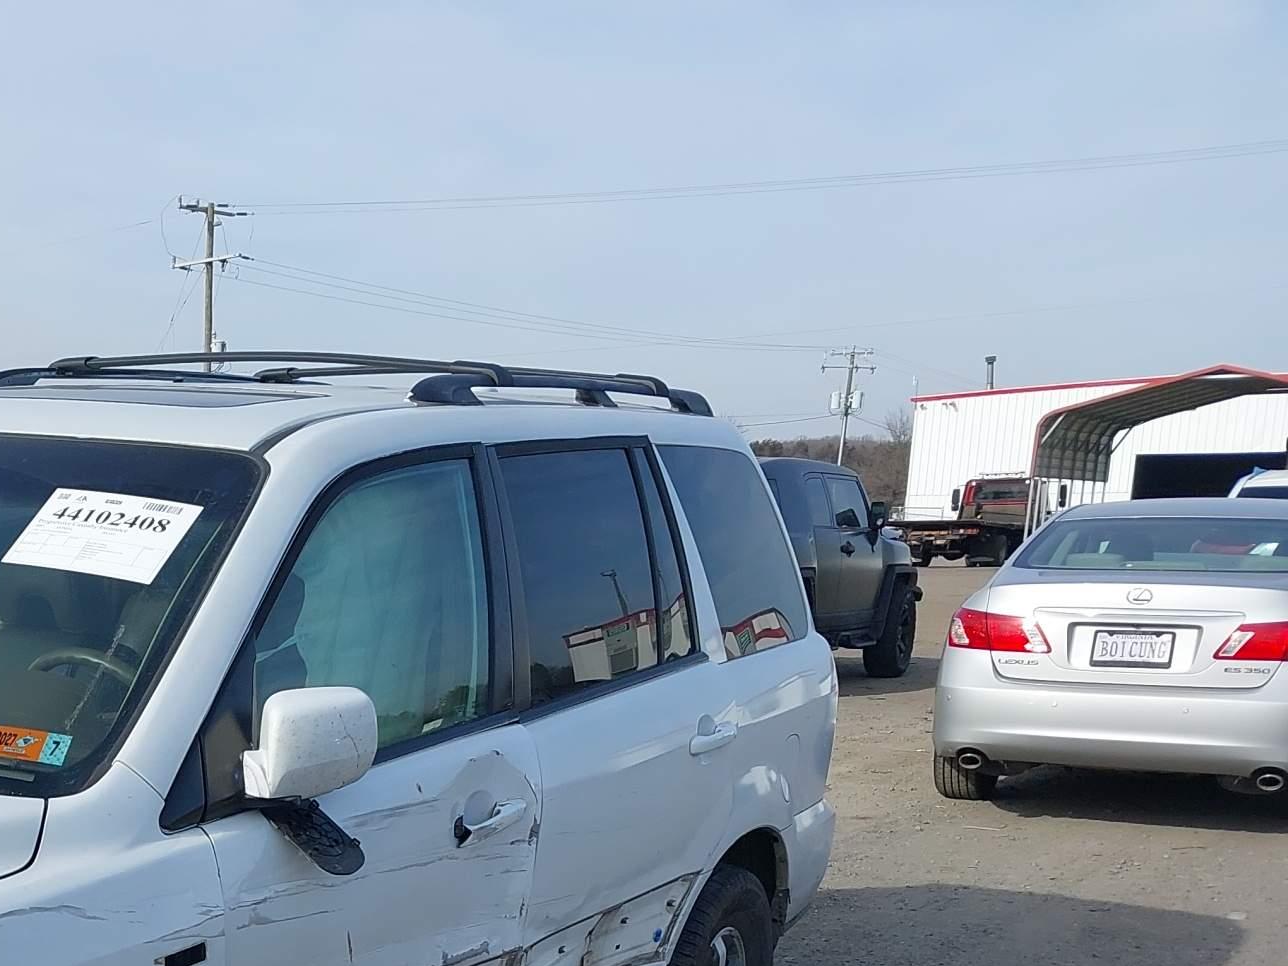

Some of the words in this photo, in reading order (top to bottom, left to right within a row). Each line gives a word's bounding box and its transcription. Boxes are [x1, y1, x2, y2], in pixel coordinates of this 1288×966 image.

[52, 506, 172, 534] 44102408
[1244, 667, 1271, 675] 350
[49, 740, 61, 757] 7
